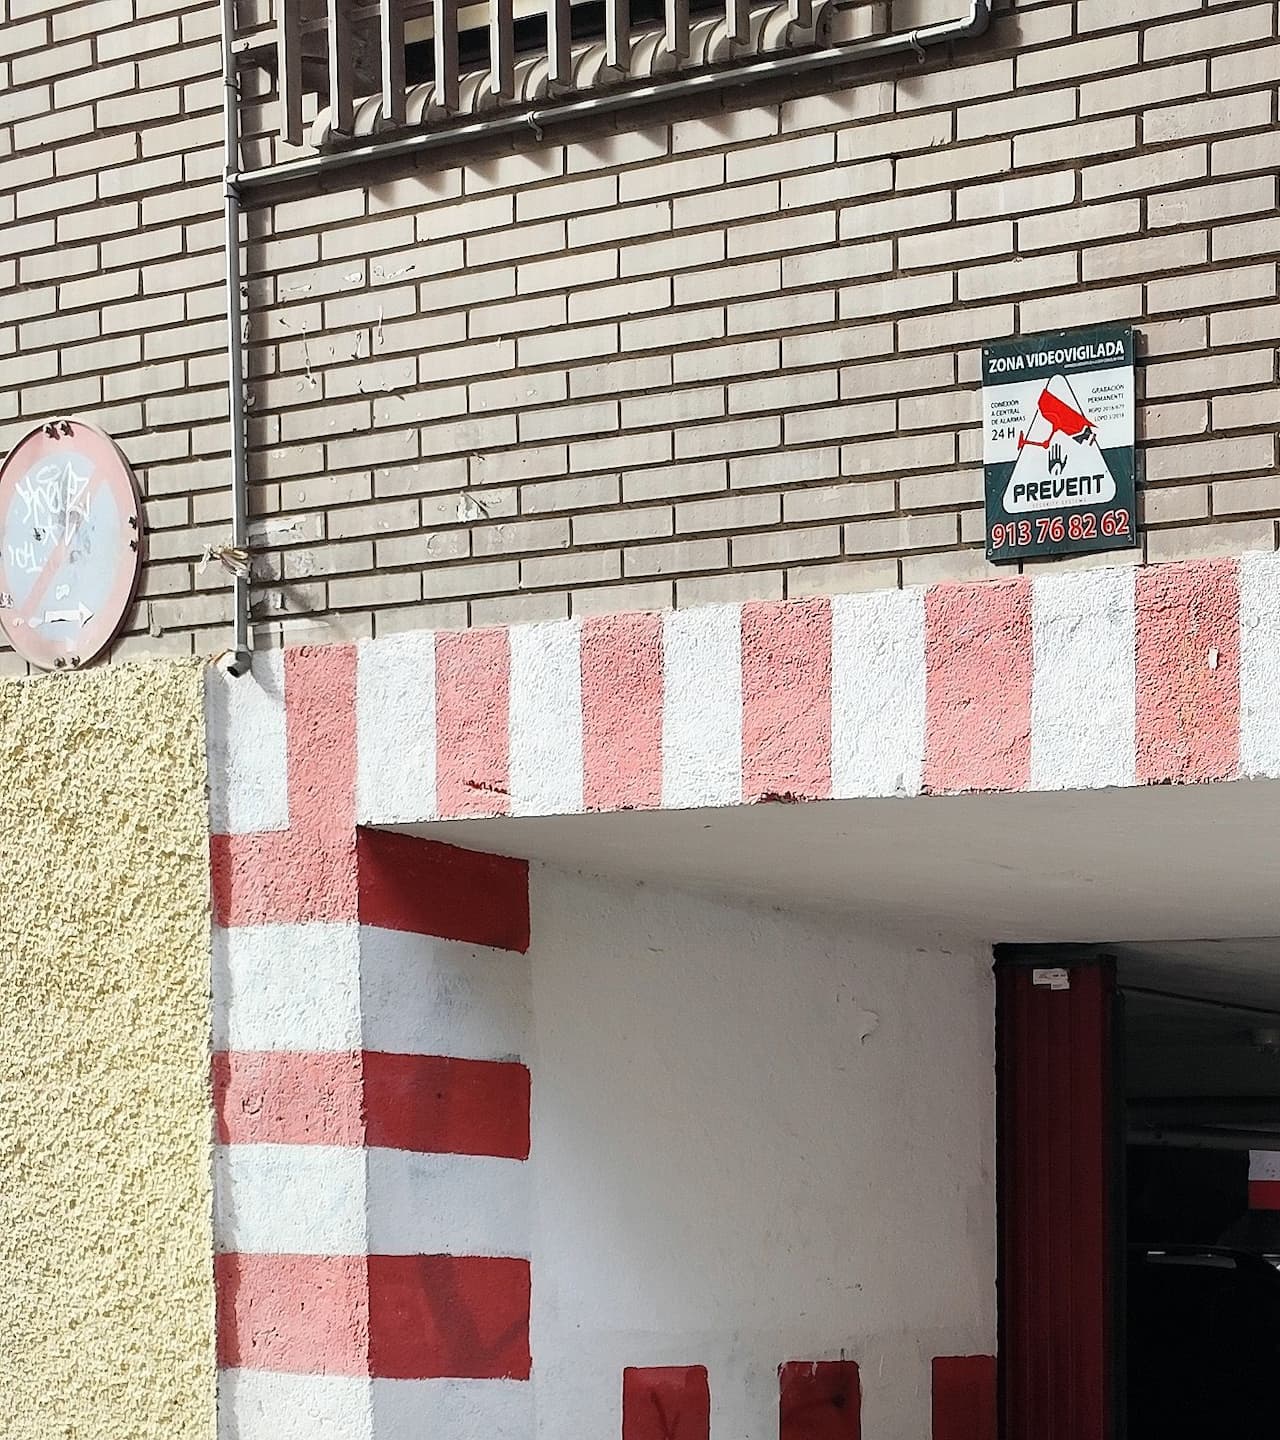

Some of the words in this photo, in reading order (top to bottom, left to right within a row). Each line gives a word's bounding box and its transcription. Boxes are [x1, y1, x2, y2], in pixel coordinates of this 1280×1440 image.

[988, 355, 1025, 374] ZONA
[1025, 339, 1125, 369] VIDEOVIGILADA
[991, 429, 1004, 440] 24
[1007, 427, 1015, 439] H
[1013, 474, 1105, 503] PREVENT
[991, 519, 1032, 549] 913
[1036, 516, 1065, 543] 76
[1068, 512, 1097, 540] 82
[1101, 508, 1130, 536] 62
